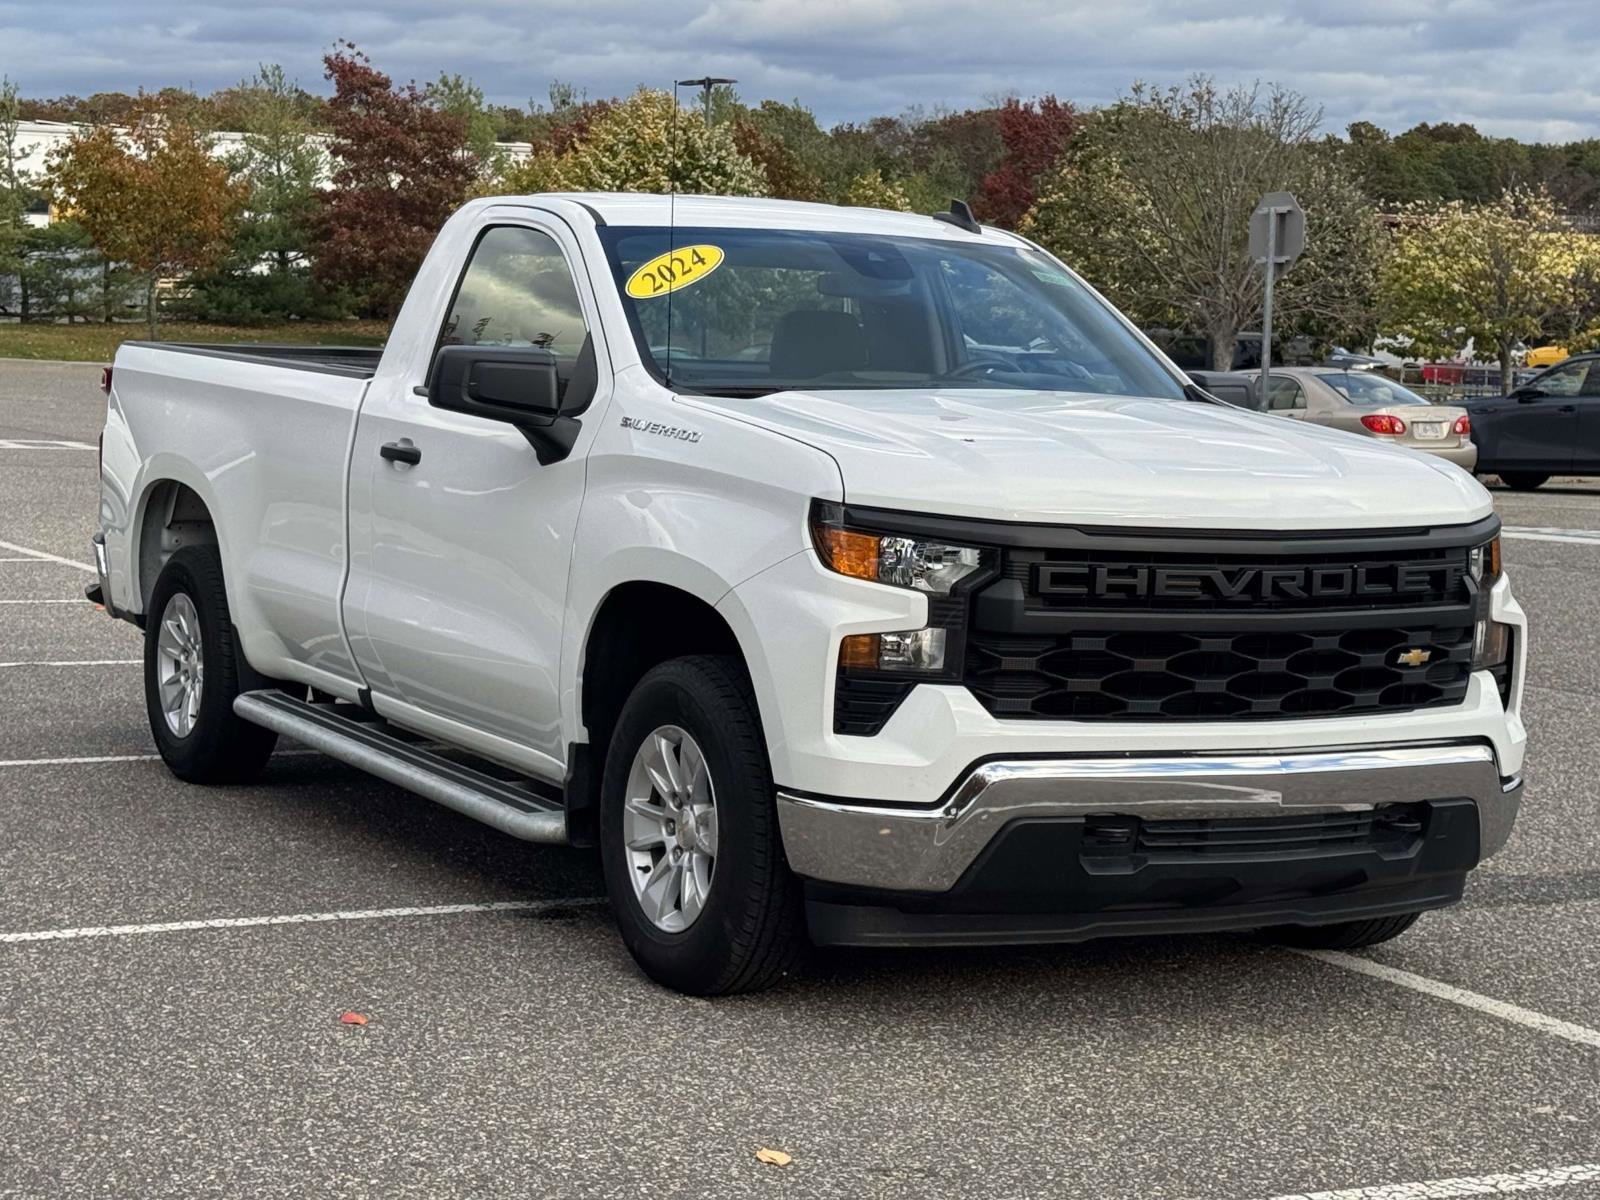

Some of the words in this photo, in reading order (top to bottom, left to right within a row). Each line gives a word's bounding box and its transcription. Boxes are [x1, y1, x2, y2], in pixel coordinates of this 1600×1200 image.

[641, 248, 706, 292] 2024
[620, 416, 703, 443] SILVERADO
[1035, 563, 1466, 599] CHEVROLET
